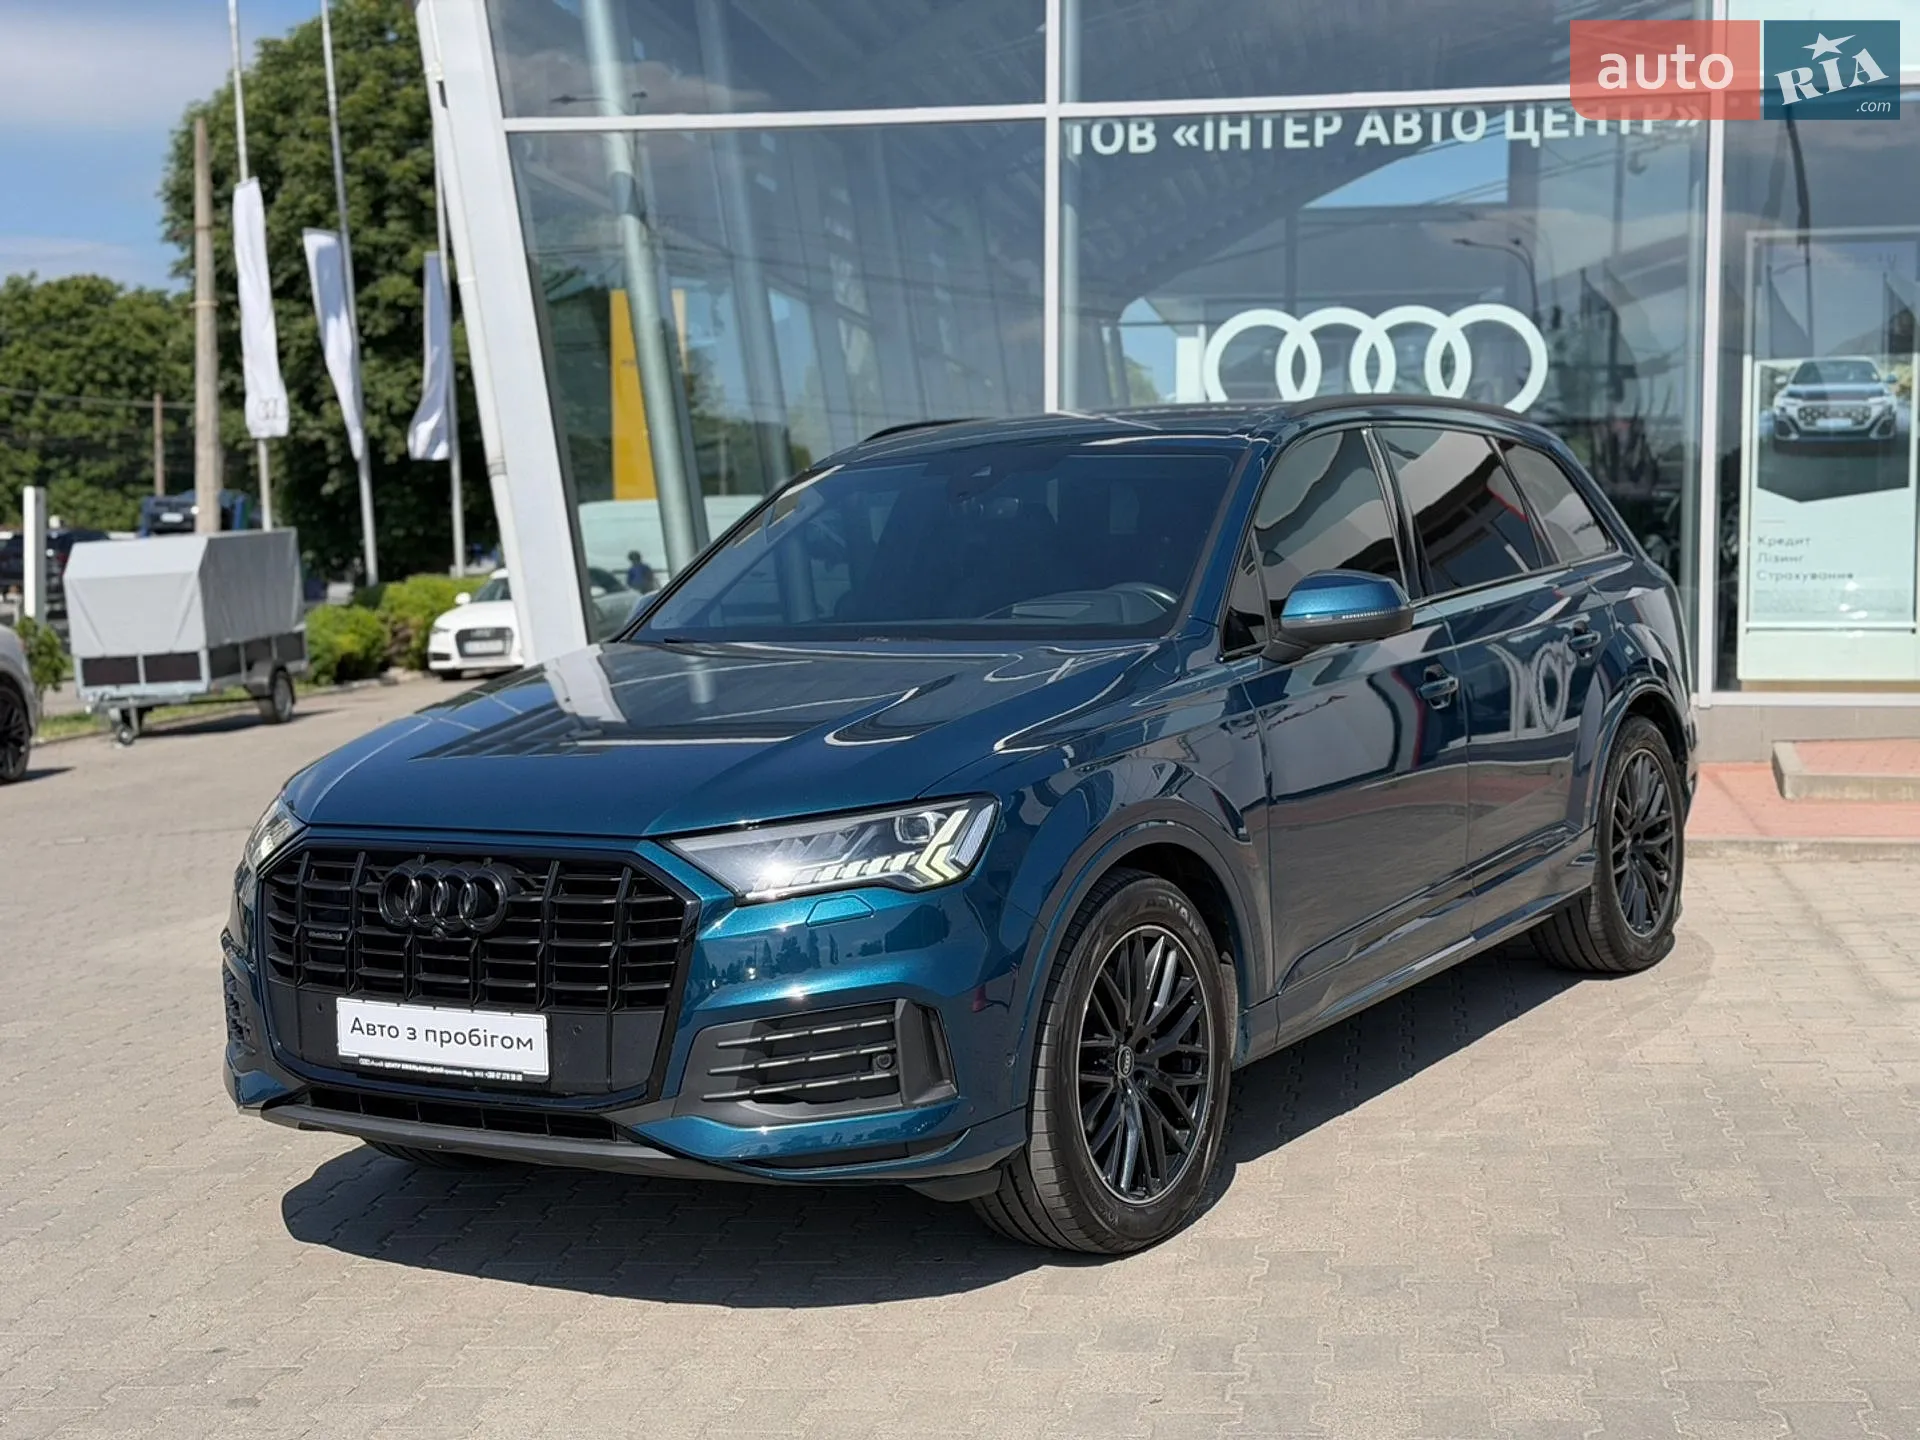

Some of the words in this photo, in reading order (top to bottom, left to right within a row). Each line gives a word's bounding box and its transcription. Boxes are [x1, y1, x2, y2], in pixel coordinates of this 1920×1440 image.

[1066, 118, 1157, 155] ТОВ
[1354, 104, 1488, 147] АВТО
[1757, 535, 1811, 547] Кредит
[350, 1016, 400, 1039] Авто
[406, 1026, 417, 1041] з
[425, 1028, 534, 1051] пробігом
